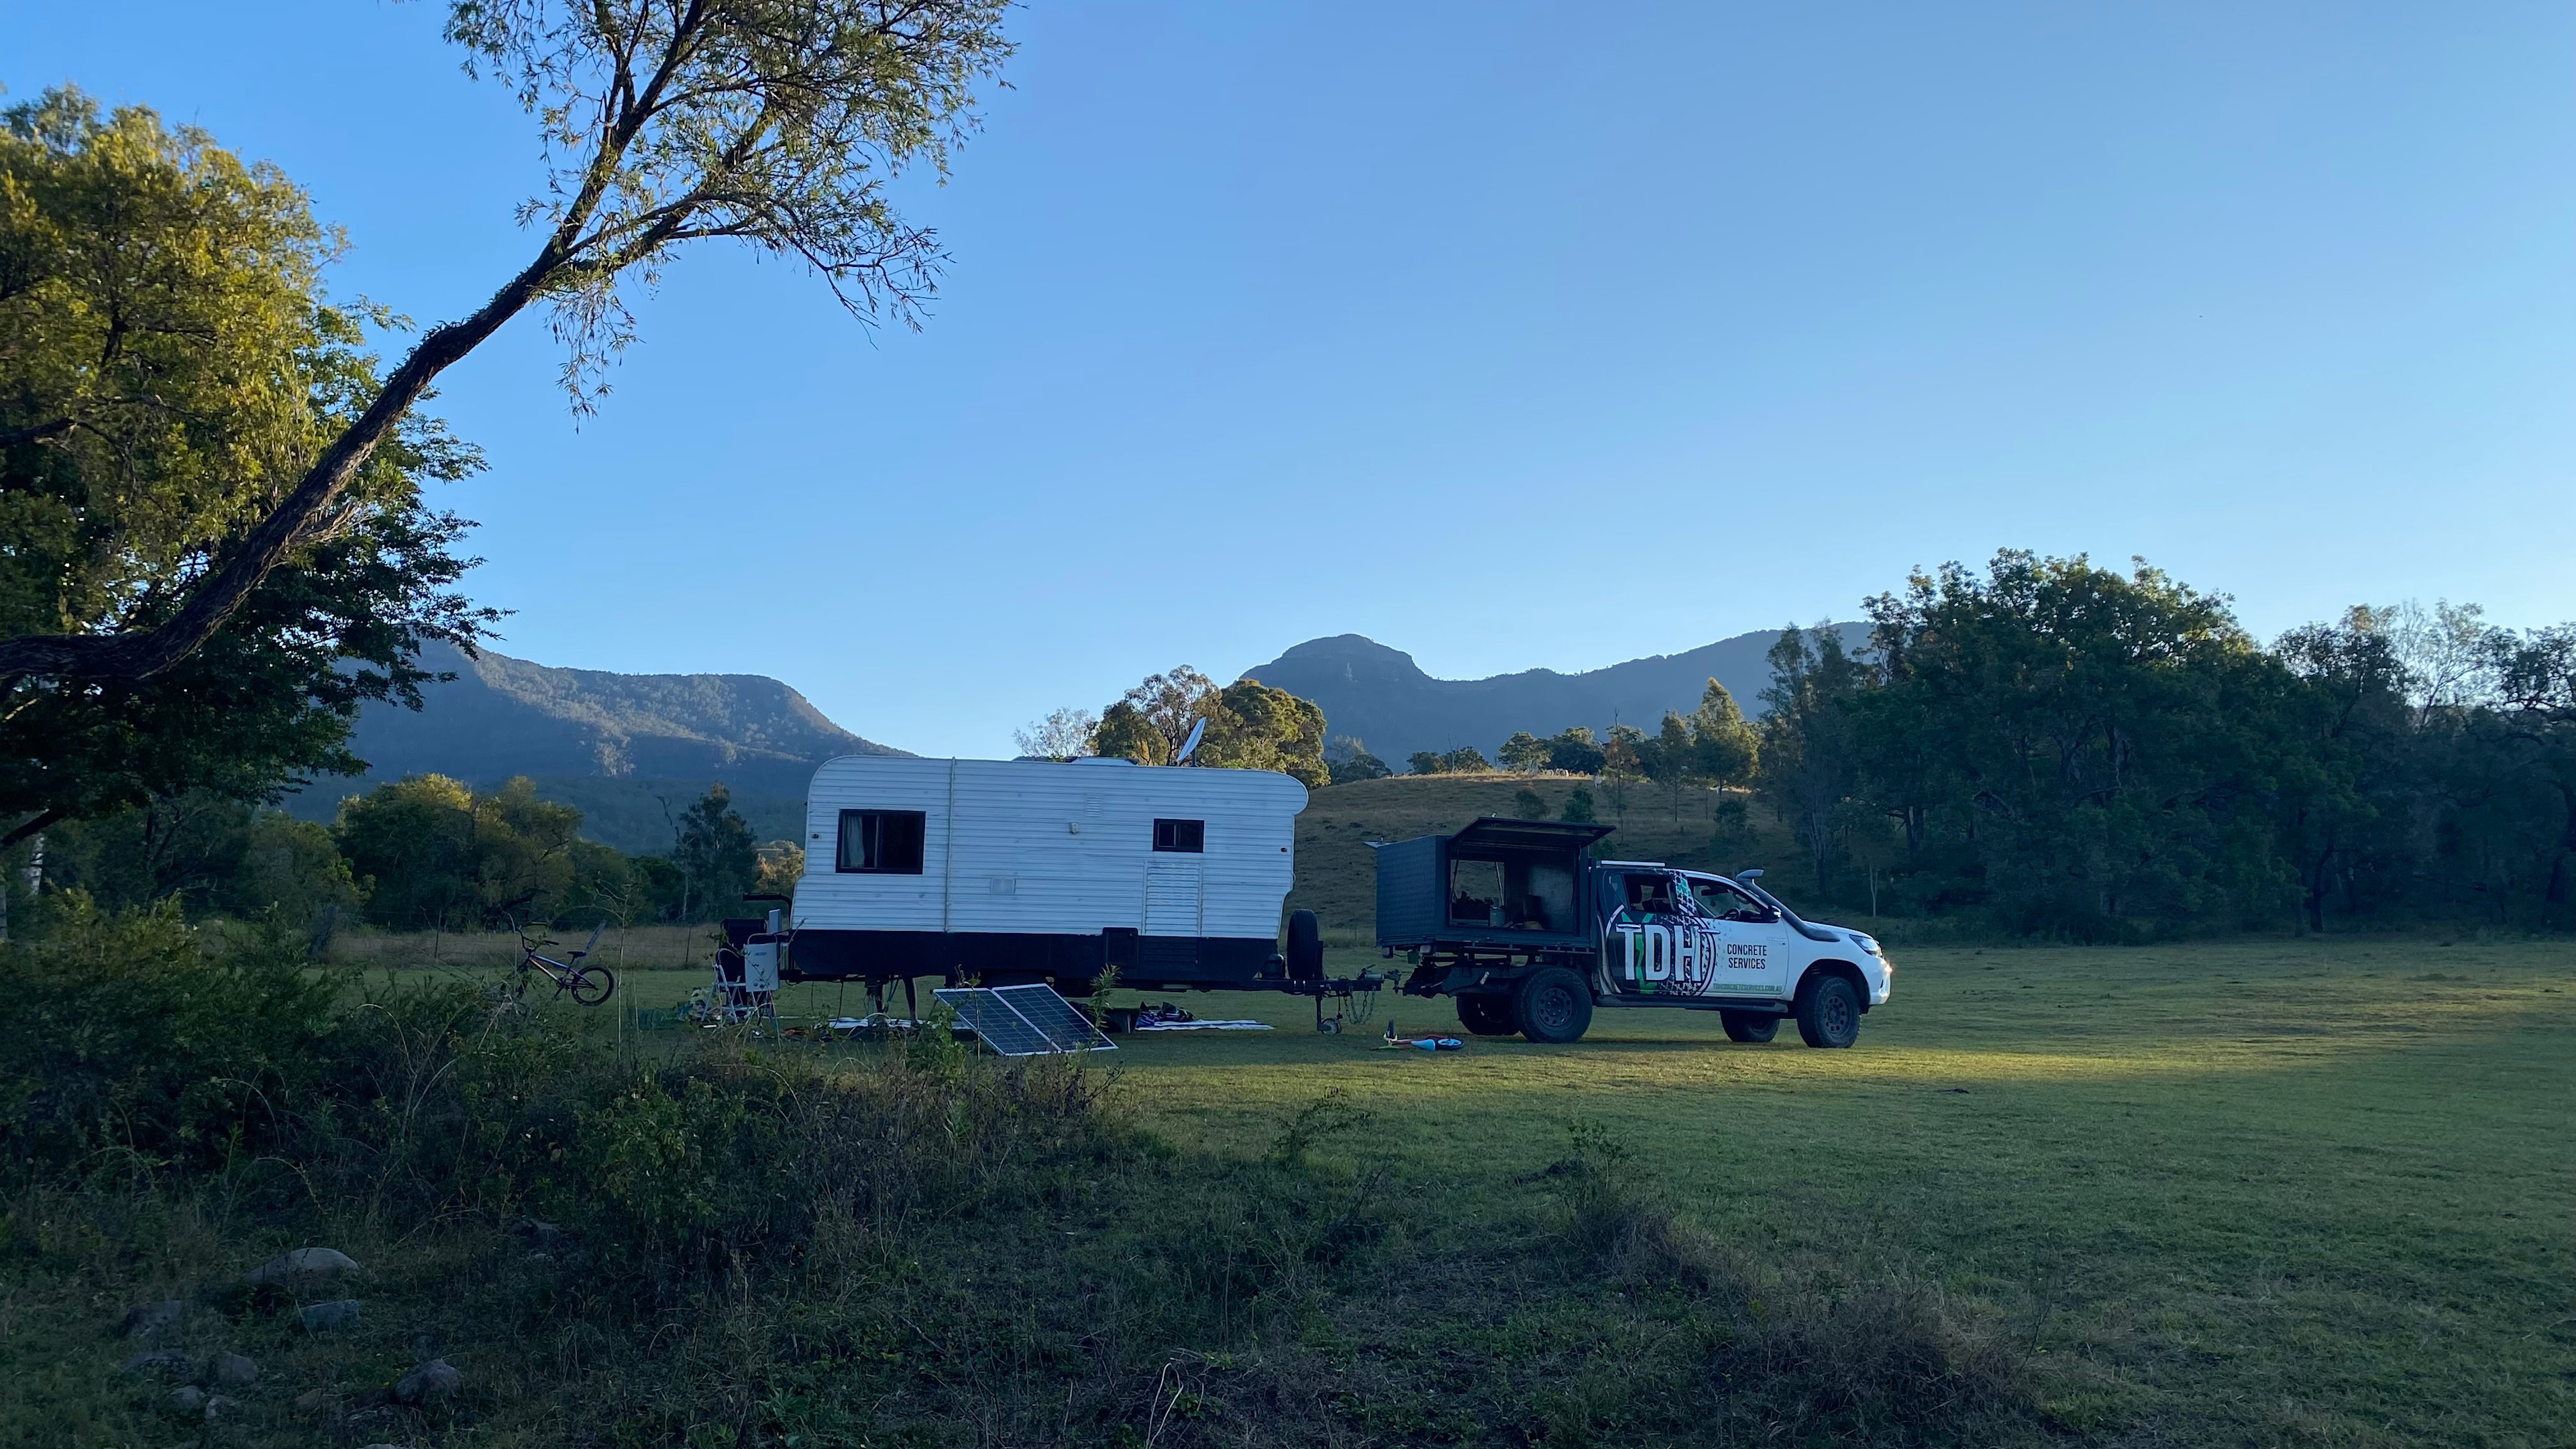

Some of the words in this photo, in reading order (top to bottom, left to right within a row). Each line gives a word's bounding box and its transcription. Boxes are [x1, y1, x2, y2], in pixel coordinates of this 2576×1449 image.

[1615, 924, 1701, 981] TDH
[1727, 944, 1767, 956] CONCRETE
[1728, 957, 1766, 969] SERVICES
